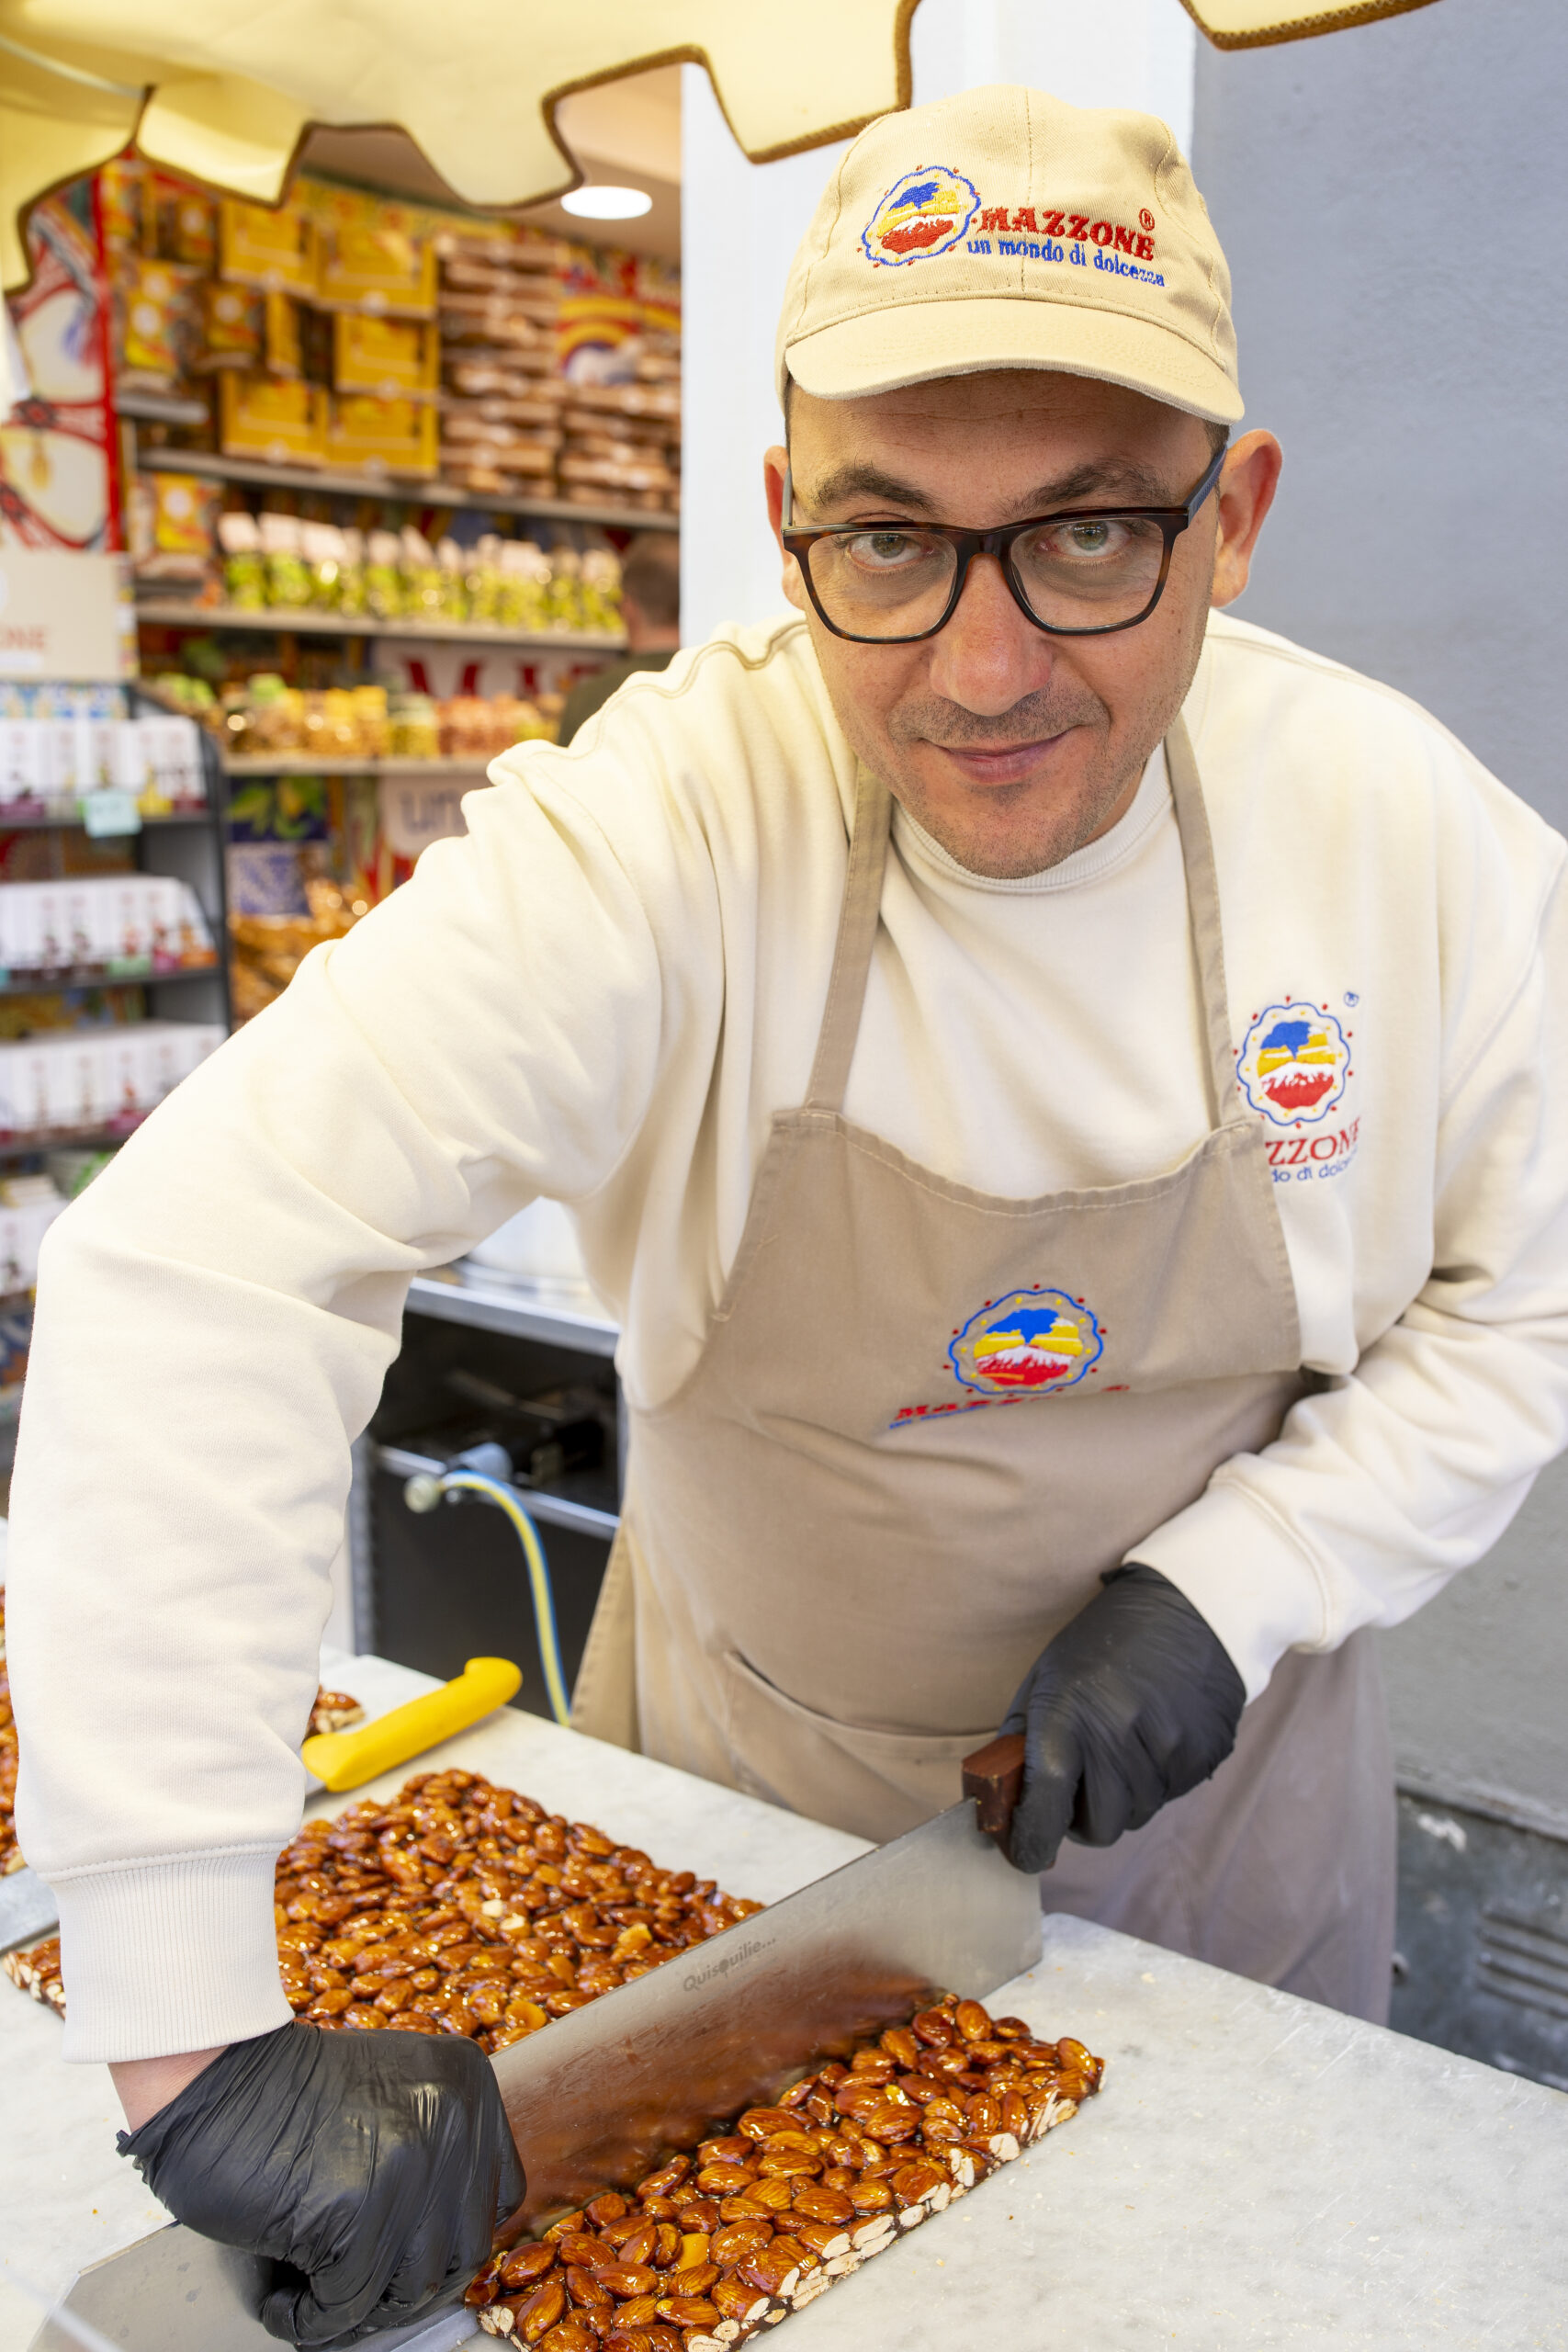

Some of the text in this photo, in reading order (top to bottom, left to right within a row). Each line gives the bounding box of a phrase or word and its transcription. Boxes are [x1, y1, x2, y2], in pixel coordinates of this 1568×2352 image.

[976, 207, 1156, 261] MAZZONE
[967, 239, 1165, 288] un mondo di dolcezza
